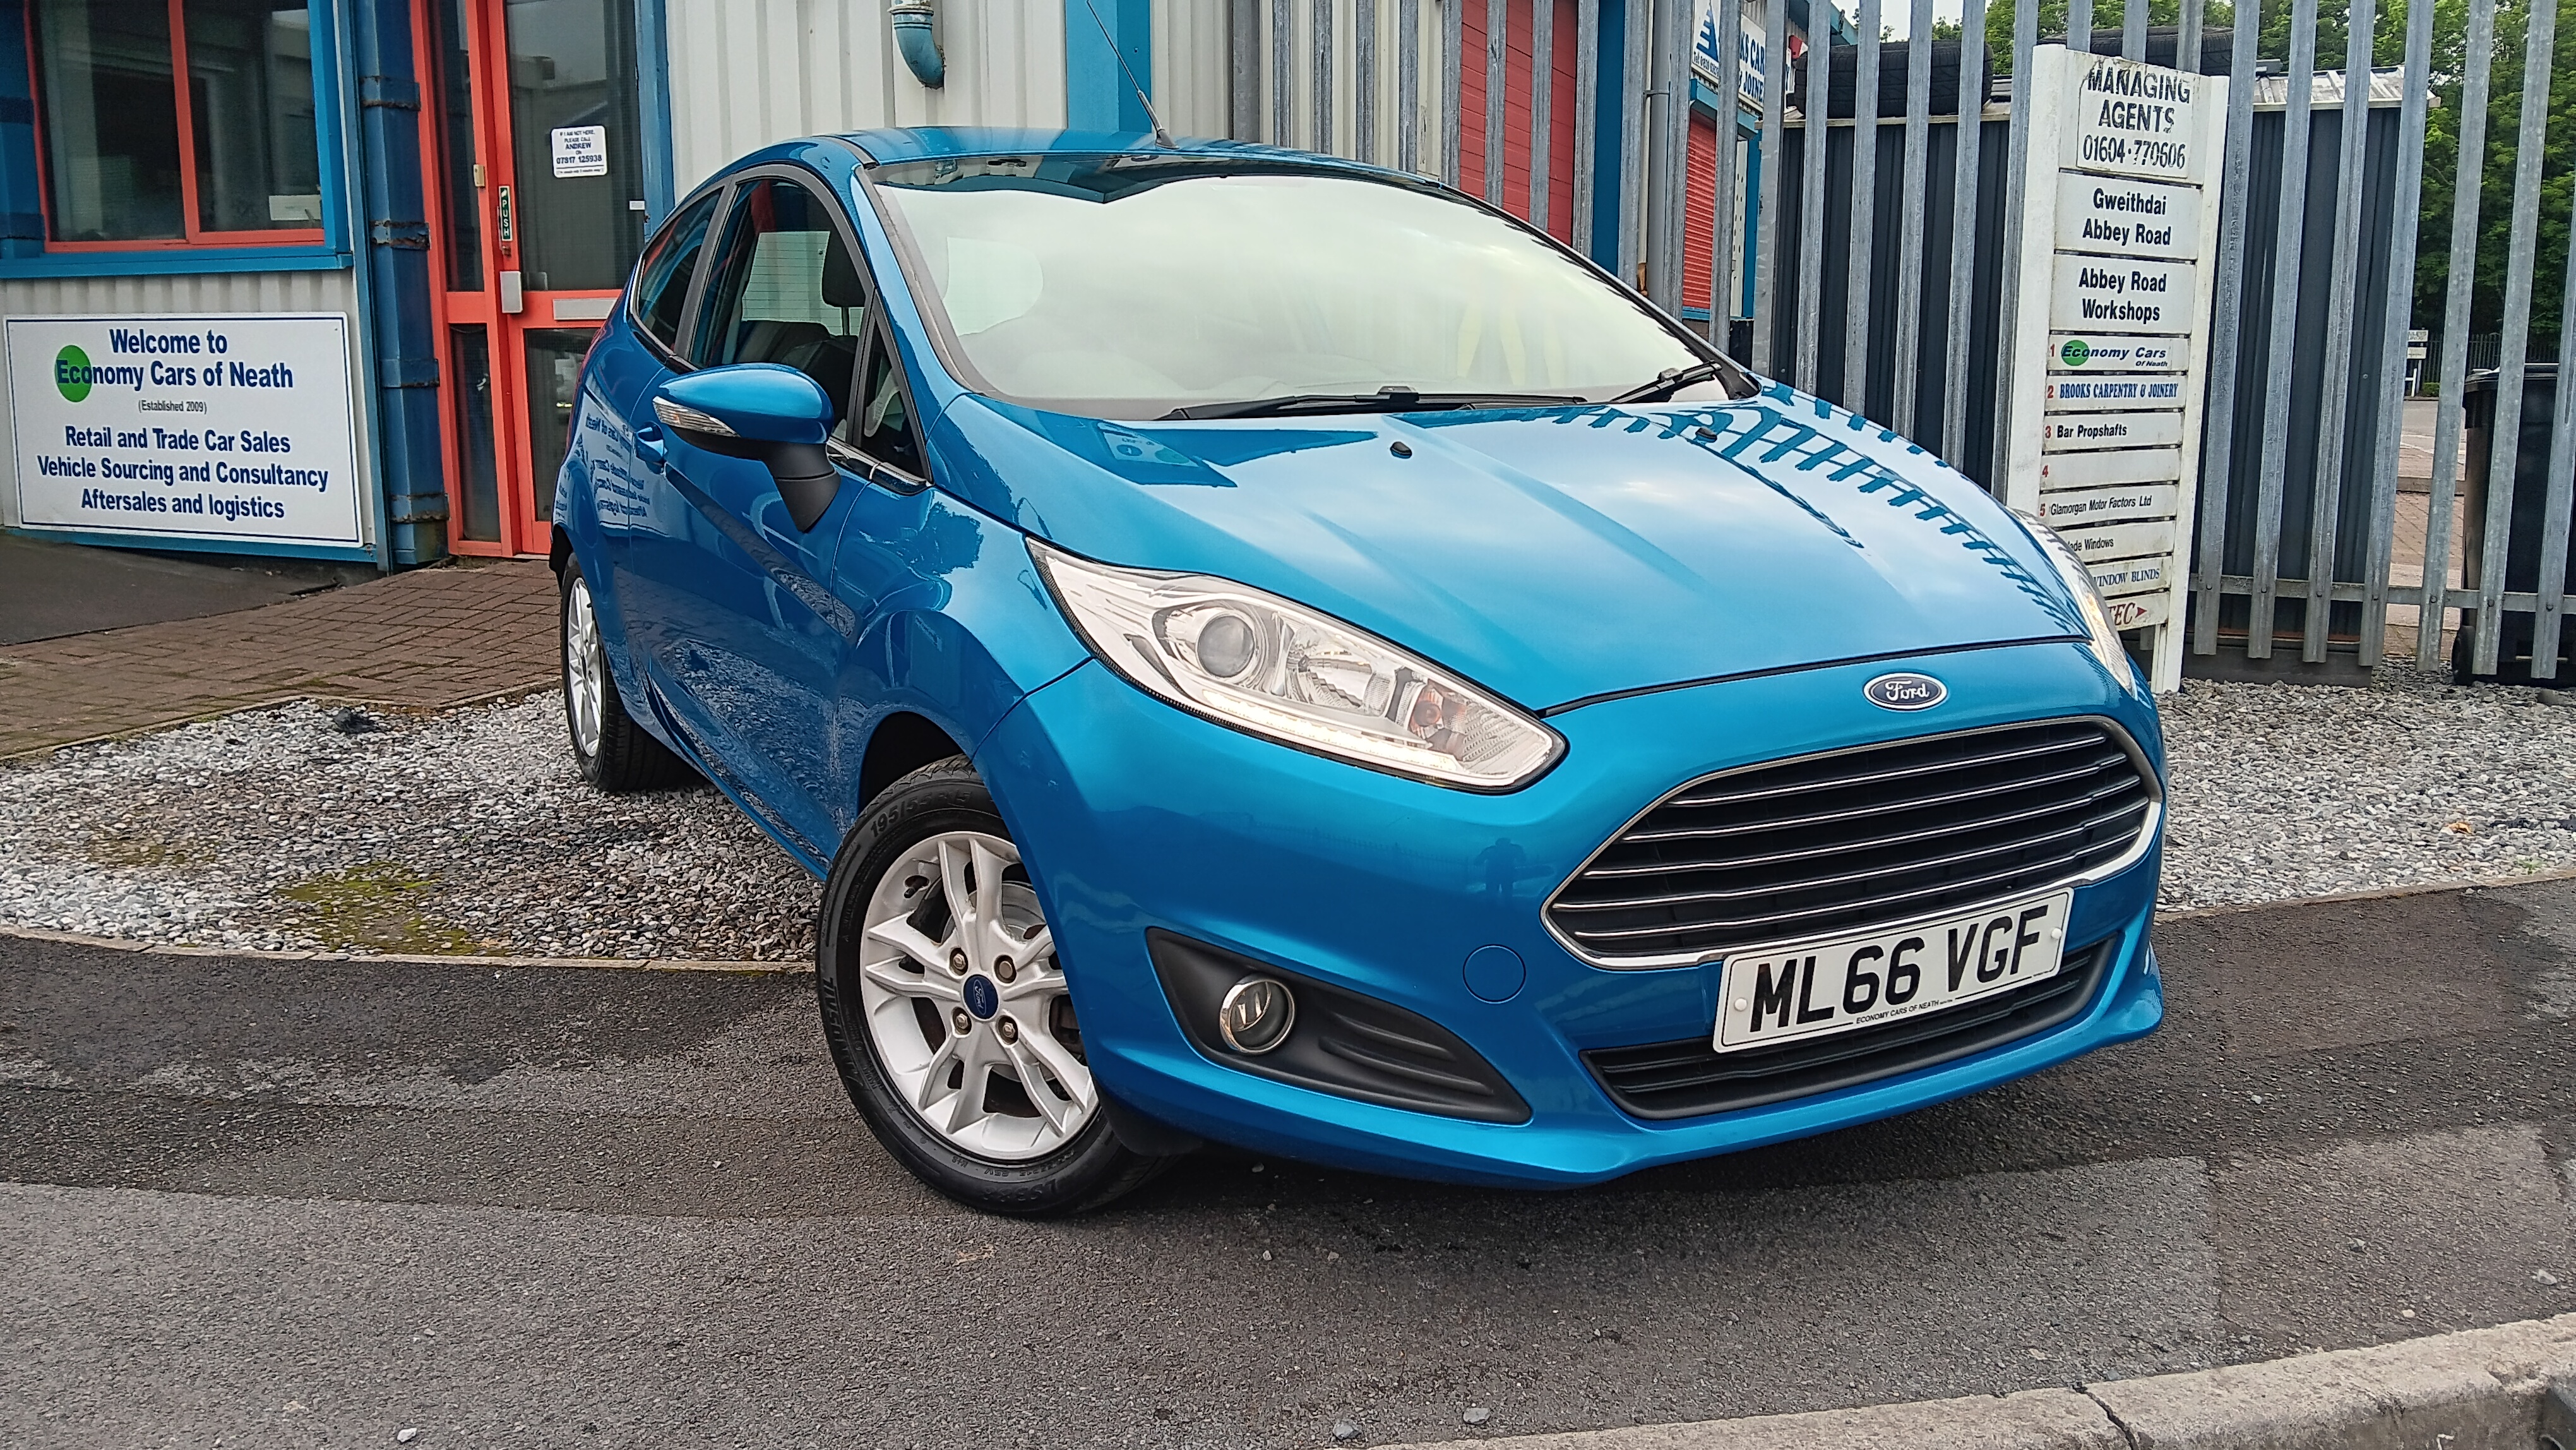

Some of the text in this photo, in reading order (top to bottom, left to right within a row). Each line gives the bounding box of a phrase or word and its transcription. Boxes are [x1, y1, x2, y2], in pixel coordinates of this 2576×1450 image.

[2088, 67, 2190, 104] MANAGING
[2098, 99, 2174, 133] AGENTS
[2093, 188, 2166, 215] Gweithdai
[2082, 218, 2171, 246] Abbey Road
[2078, 267, 2167, 294] Abbey Road
[2082, 298, 2160, 325] Workshops
[109, 328, 228, 354] Welcome to
[2050, 344, 2166, 361] 1 Economy Cars
[56, 359, 294, 391] Economy Cars of Neath
[2047, 383, 2178, 398] 2 BROOKS CARPENTRY & JOINERY
[138, 399, 207, 414] (Established 2009)
[65, 425, 291, 453] Retail and Trade Car Sales
[2045, 423, 2127, 440] 3 Bar Propshafts
[37, 455, 328, 492] Vehicle Sourcing and Consultancy
[2042, 465, 2049, 477] 4
[81, 488, 285, 520] Aftersales and logistics
[2039, 495, 2152, 516] 5 Glamorgan Motor Factors Ltd
[2084, 537, 2114, 550] Windows
[2132, 568, 2160, 582] BLINDS
[1885, 680, 1930, 701] Ford
[1750, 904, 2049, 1033] ML66 VGF
[974, 986, 984, 1009] Ford
[1856, 1010, 1890, 1024] ECONOMY
[1892, 1008, 1907, 1017] CARS
[1919, 1000, 1940, 1009] NEATH
